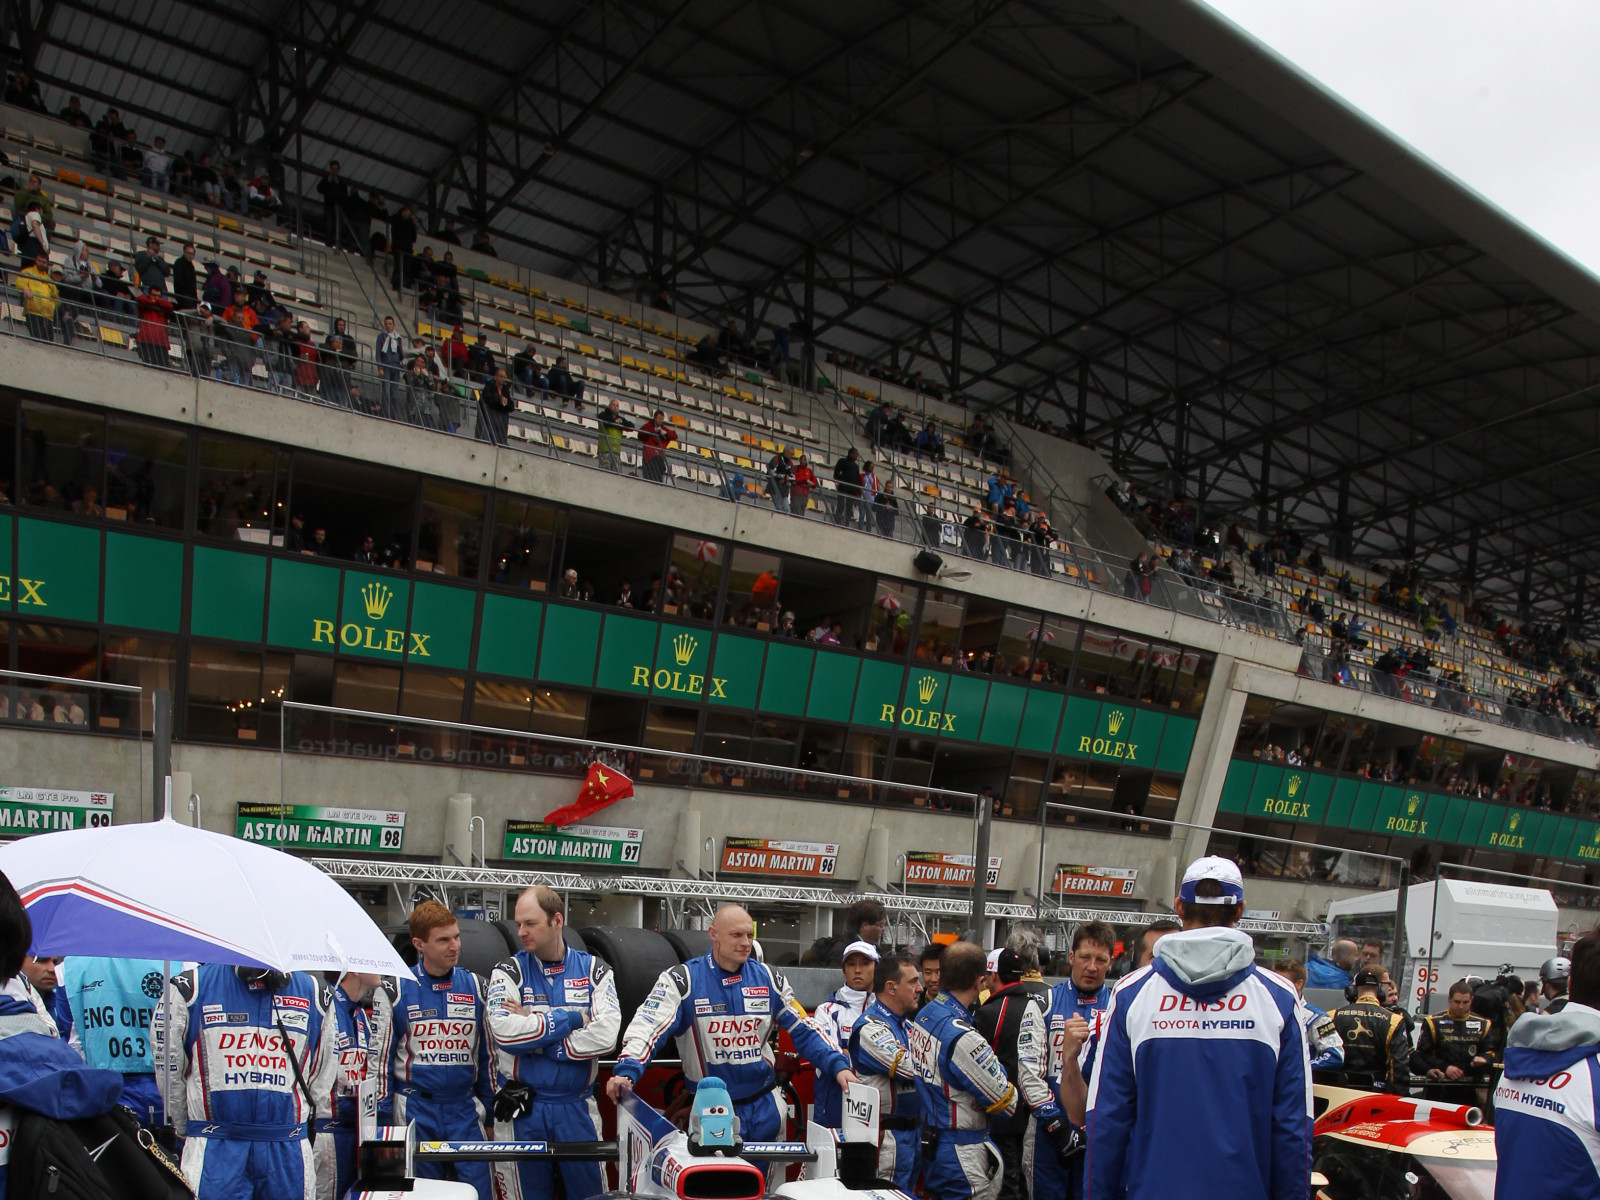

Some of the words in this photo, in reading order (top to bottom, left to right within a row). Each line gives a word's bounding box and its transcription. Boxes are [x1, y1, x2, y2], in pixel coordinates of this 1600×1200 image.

[312, 619, 431, 657] ROLEX
[631, 665, 728, 698] ROLEX
[880, 703, 956, 732] ROLEX
[1078, 735, 1138, 760] ROLEX
[1263, 798, 1311, 818] ROLEX
[0, 808, 74, 830] MARTIN
[1385, 816, 1428, 834] ROLEX
[243, 822, 300, 842] ASTON
[306, 825, 372, 846] MARTIN
[384, 830, 400, 846] 98
[1489, 832, 1526, 849] ROLEX
[512, 837, 557, 855] ASTON
[560, 840, 613, 859] MARTIN
[624, 845, 639, 860] 97
[1577, 845, 1600, 859] ROLE
[727, 851, 767, 868] ASTON
[769, 855, 816, 871] MARTIN
[822, 858, 833, 873] 96
[907, 864, 941, 880] ASTON
[943, 867, 976, 882] MART
[987, 871, 997, 883] 95
[1064, 877, 1114, 892] FERRARI
[573, 979, 589, 987] TOTA
[1418, 968, 1439, 983] 95
[284, 998, 309, 1008] TOTAL
[1159, 994, 1247, 1012] DENSO
[83, 1006, 115, 1029] ENG
[206, 1014, 225, 1023] ZENT
[547, 1012, 556, 1036] TOTA
[707, 1017, 763, 1034] DENSO
[1152, 1020, 1200, 1030] TOYOTA
[1202, 1020, 1255, 1030] HYBRID
[413, 1022, 473, 1037] DENSO
[109, 1037, 146, 1058] 063
[218, 1032, 296, 1053] DENSO
[418, 1039, 470, 1051] TOYOTA
[712, 1035, 760, 1048] TOYOTA
[224, 1053, 287, 1071] TOYOTA
[420, 1053, 470, 1063] HYBRID
[714, 1047, 762, 1060] HYBRID
[224, 1071, 286, 1087] HYBRID
[846, 1098, 868, 1118] TMG
[1521, 1093, 1566, 1115] HYBRID
[458, 1143, 545, 1151] MICHELIN
[743, 1144, 806, 1152] CHELIN
